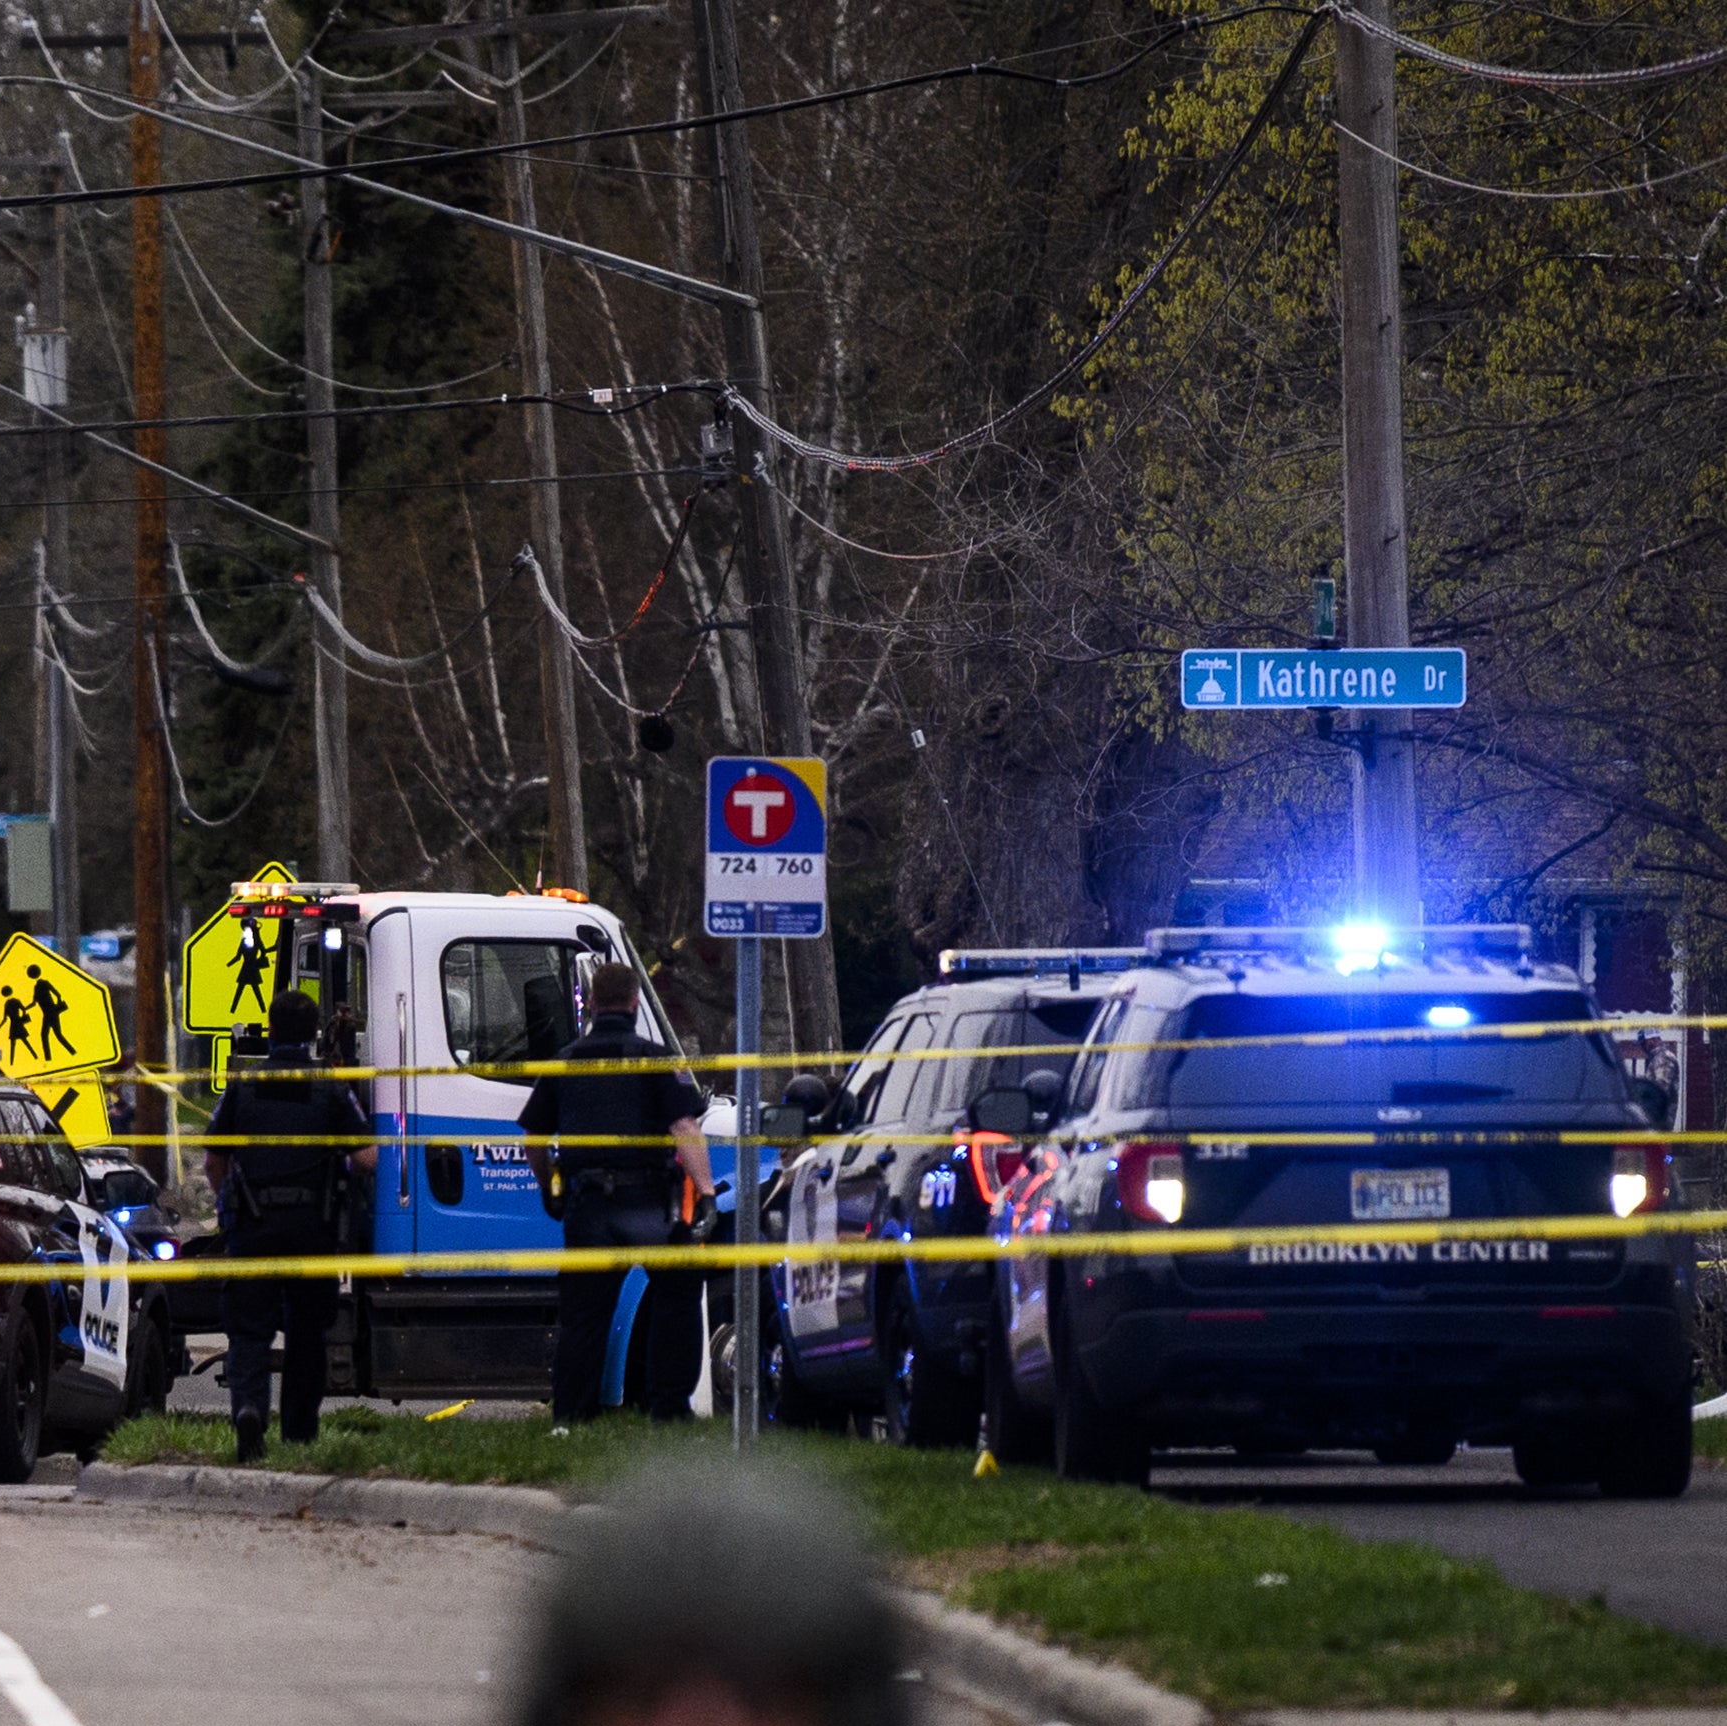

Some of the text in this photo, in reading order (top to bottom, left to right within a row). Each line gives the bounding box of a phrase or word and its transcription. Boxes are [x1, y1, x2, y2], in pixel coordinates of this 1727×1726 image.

[1258, 660, 1447, 698] Kathrene Dr
[733, 790, 785, 837] T
[720, 857, 756, 874] 724
[777, 857, 813, 874] 760
[712, 917, 745, 931] 9033
[472, 1142, 527, 1161] Twi
[919, 1171, 956, 1209] 911
[1249, 1240, 1550, 1265] BROOKLYN CENTER
[85, 1313, 119, 1356] POLICE
